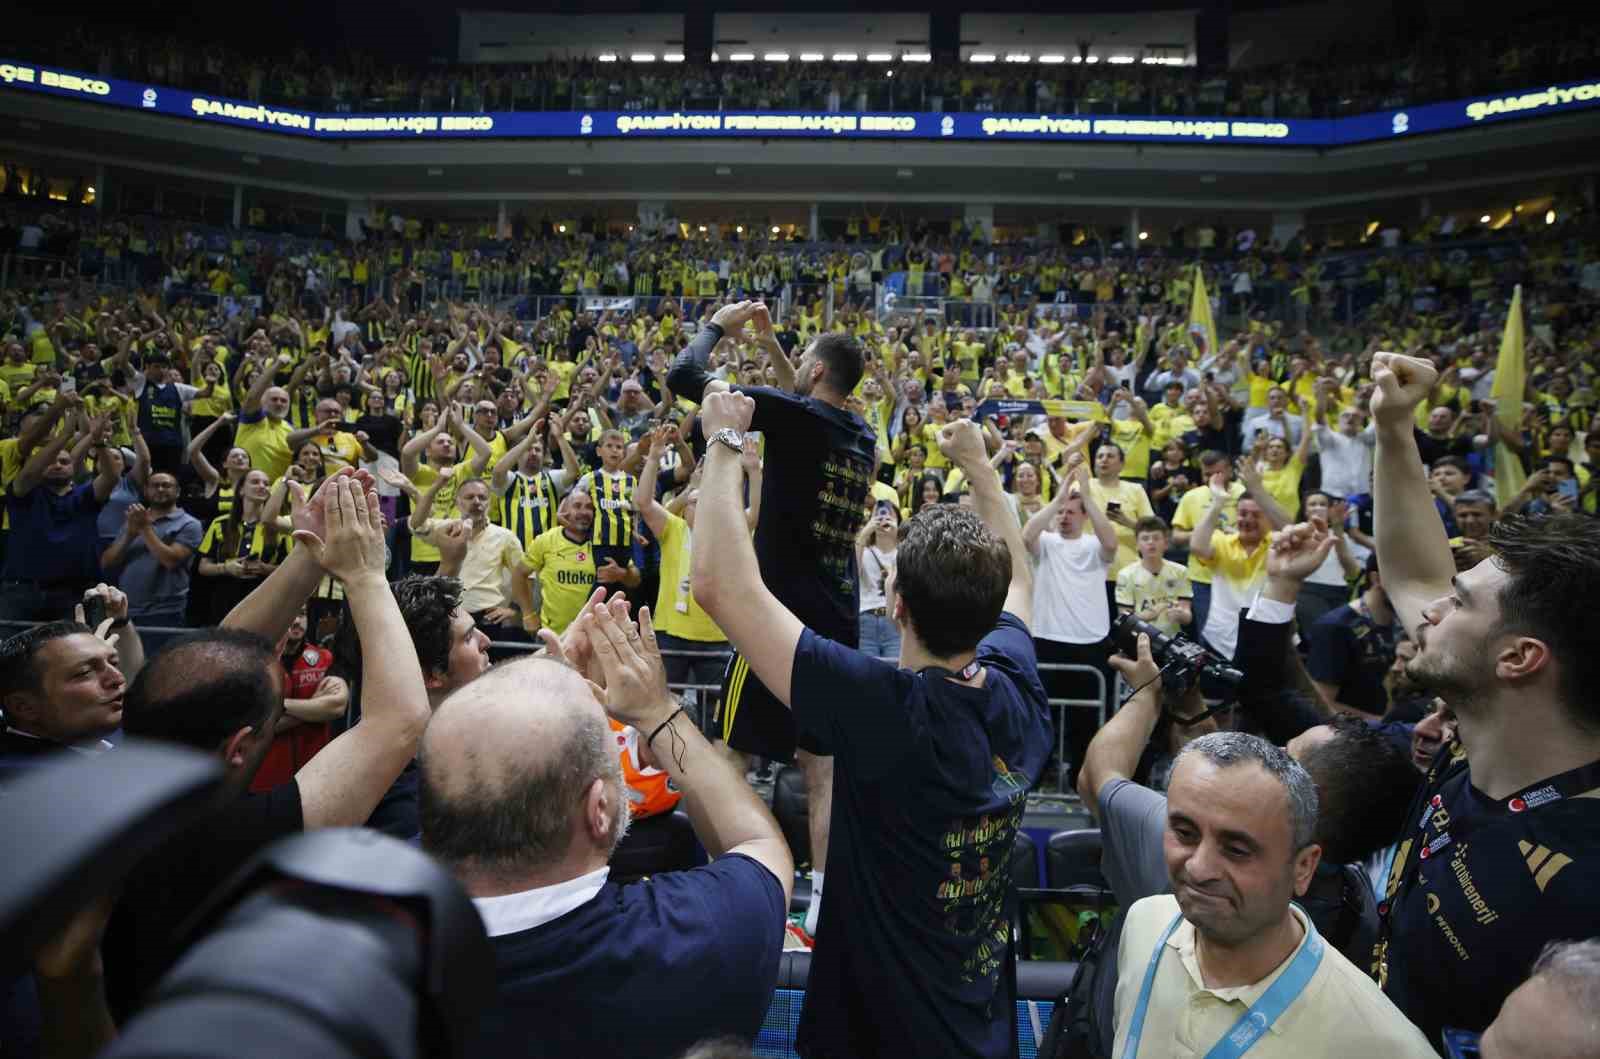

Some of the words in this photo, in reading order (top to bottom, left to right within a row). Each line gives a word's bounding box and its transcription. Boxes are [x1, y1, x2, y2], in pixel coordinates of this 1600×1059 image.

[40, 70, 111, 95] BEKO
[1466, 83, 1600, 121] ŞAMPİYO
[557, 569, 595, 585] Otoko
